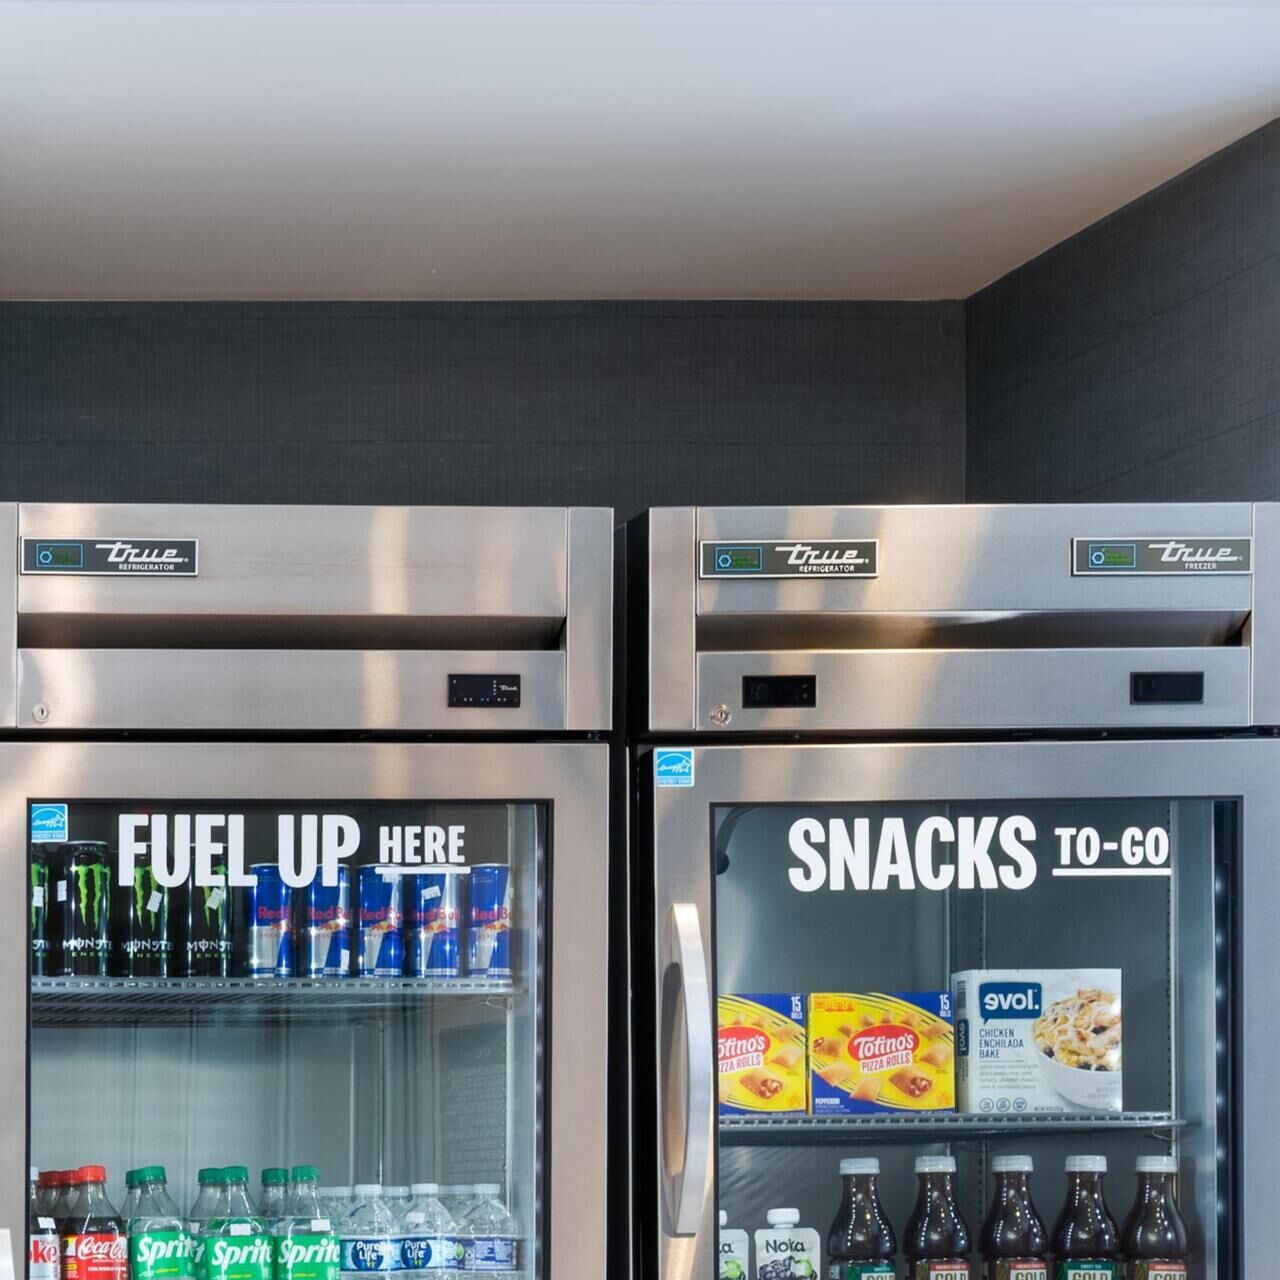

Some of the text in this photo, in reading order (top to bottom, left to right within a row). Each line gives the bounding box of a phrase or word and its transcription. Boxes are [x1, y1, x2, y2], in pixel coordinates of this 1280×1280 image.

[798, 565, 855, 573] REFRIGERATOR
[1185, 562, 1217, 570] FREEZER
[118, 814, 466, 887] FUEL UP HERE
[787, 816, 1170, 893] SNACKS TO-GO
[258, 907, 283, 919] Red
[791, 996, 801, 1012] 15
[940, 995, 950, 1011] 15
[984, 989, 1040, 1010] evol.
[979, 1029, 1014, 1038] CHICKEN
[853, 1033, 914, 1058] Totino's
[979, 1039, 1024, 1048] ENCHILADA
[979, 1049, 1000, 1058] BAKE
[737, 1055, 761, 1068] ROLLS
[862, 1056, 910, 1072] PIZZA ROLLS
[356, 1242, 379, 1251] Pure
[404, 1240, 427, 1250] Pure
[765, 1239, 806, 1253] Noka
[278, 1237, 340, 1270] Sprite
[359, 1250, 378, 1262] Life
[407, 1249, 425, 1260] Life
